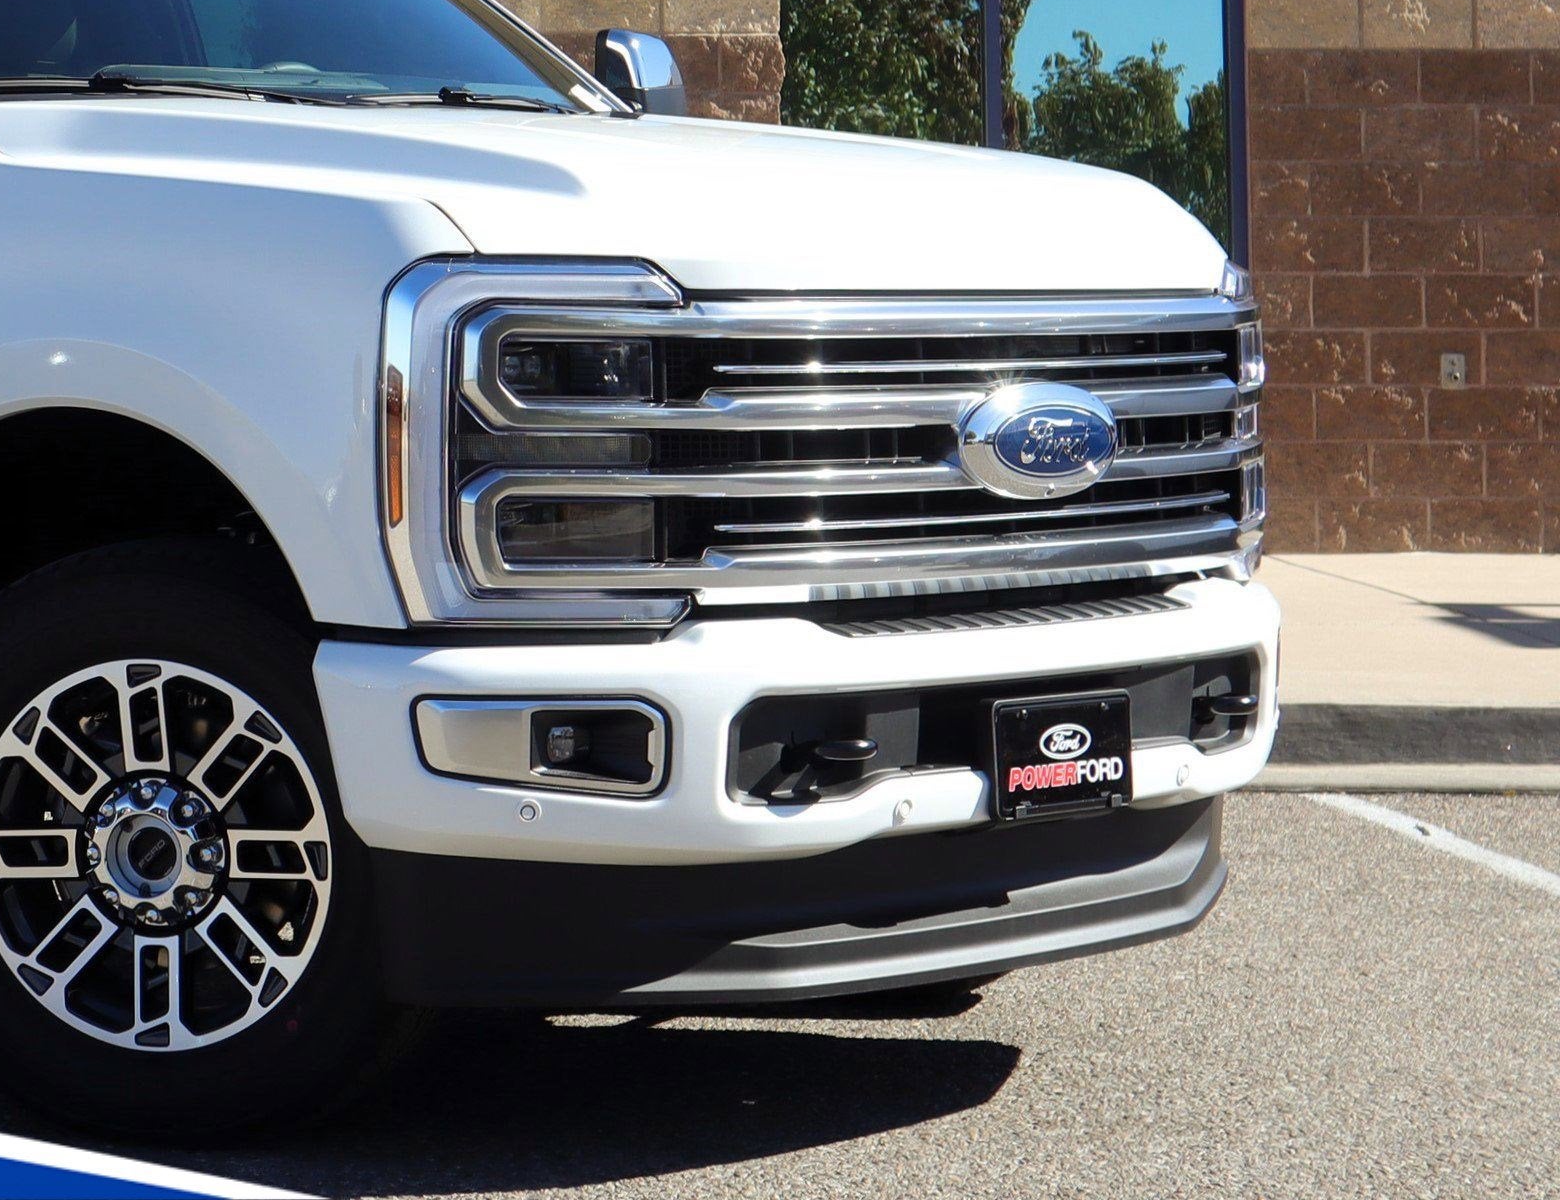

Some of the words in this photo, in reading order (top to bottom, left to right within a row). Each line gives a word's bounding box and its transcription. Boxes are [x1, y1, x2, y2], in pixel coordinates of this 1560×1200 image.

[1020, 416, 1091, 464] Ford
[1049, 730, 1081, 753] Ford
[1008, 756, 1124, 793] POWERFORD
